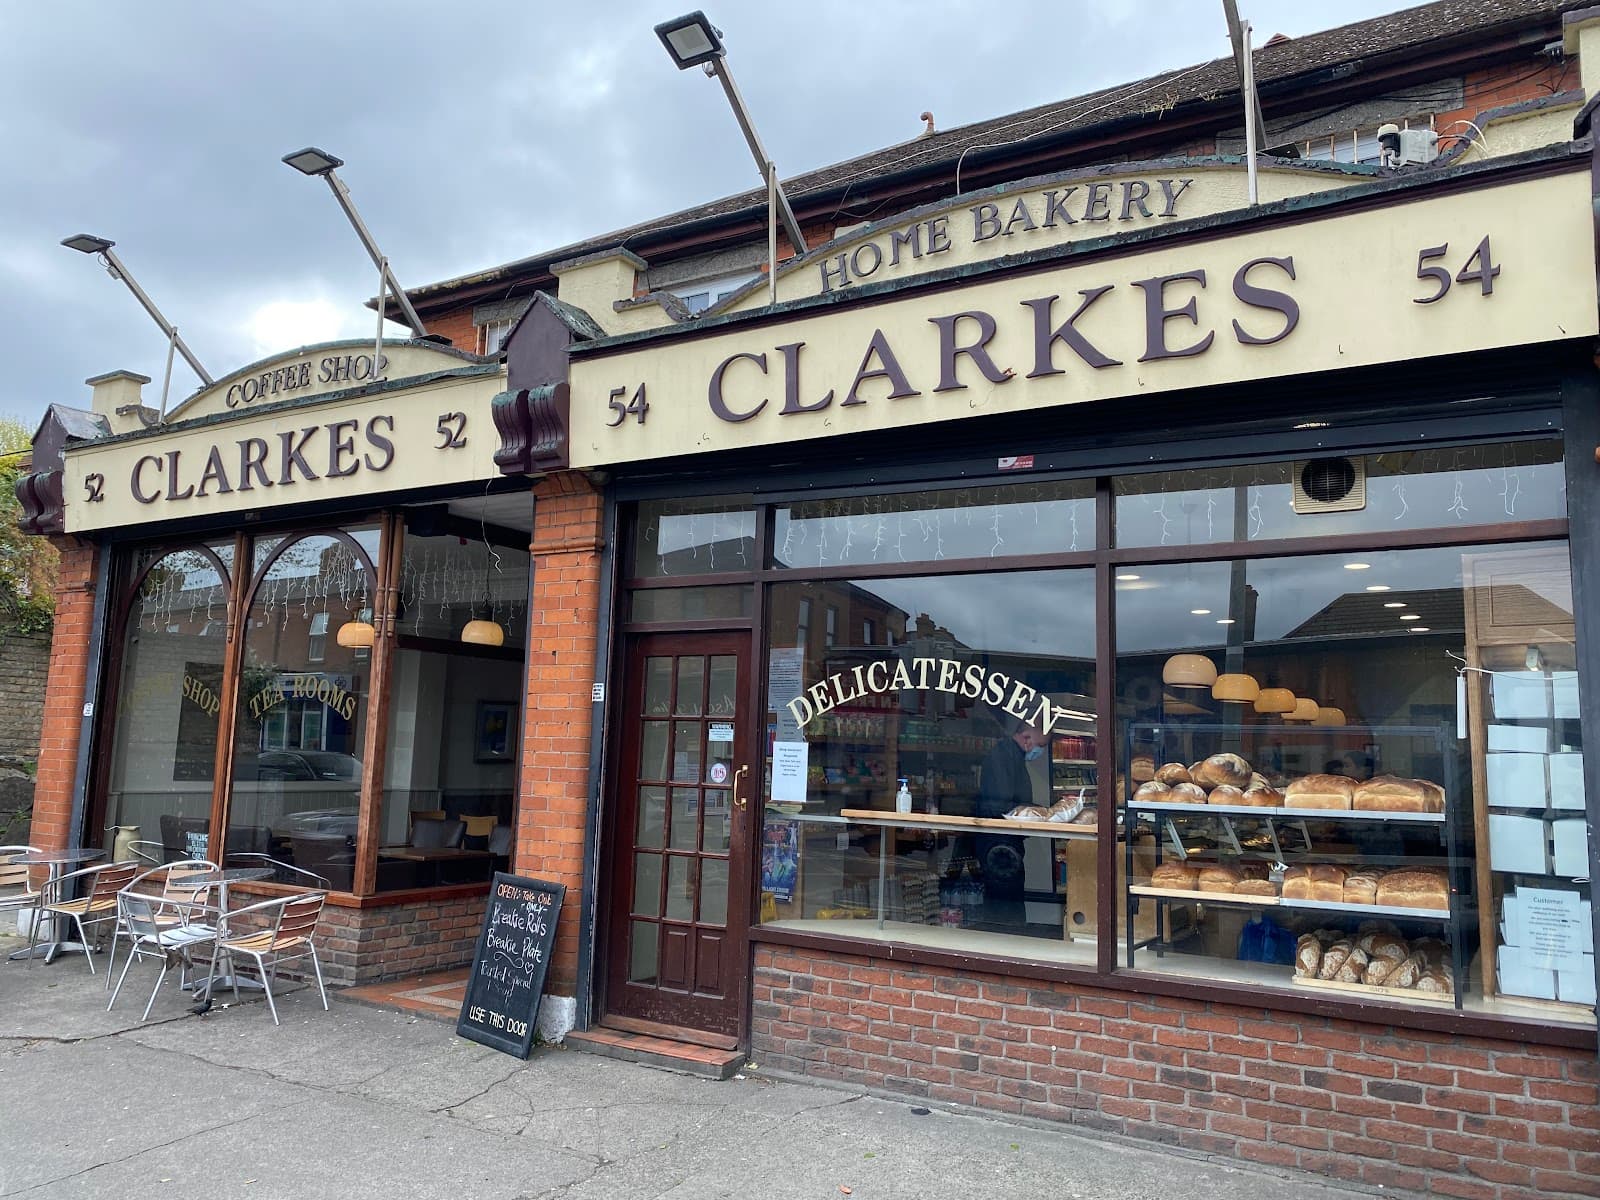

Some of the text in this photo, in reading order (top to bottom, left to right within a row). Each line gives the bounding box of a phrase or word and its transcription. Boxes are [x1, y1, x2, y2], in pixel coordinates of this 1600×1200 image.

[816, 178, 1194, 293] HOME BAKERY
[606, 234, 1502, 428] 54 CLARKES 54
[225, 353, 390, 408] COFFEE SHOP
[84, 411, 468, 505] 52 CLARKES 52
[182, 674, 221, 718] SHOP
[250, 674, 356, 722] TEA ROOMS
[785, 656, 1062, 737] DELICATESSEN
[469, 1005, 528, 1038] USE THIS DOOR
